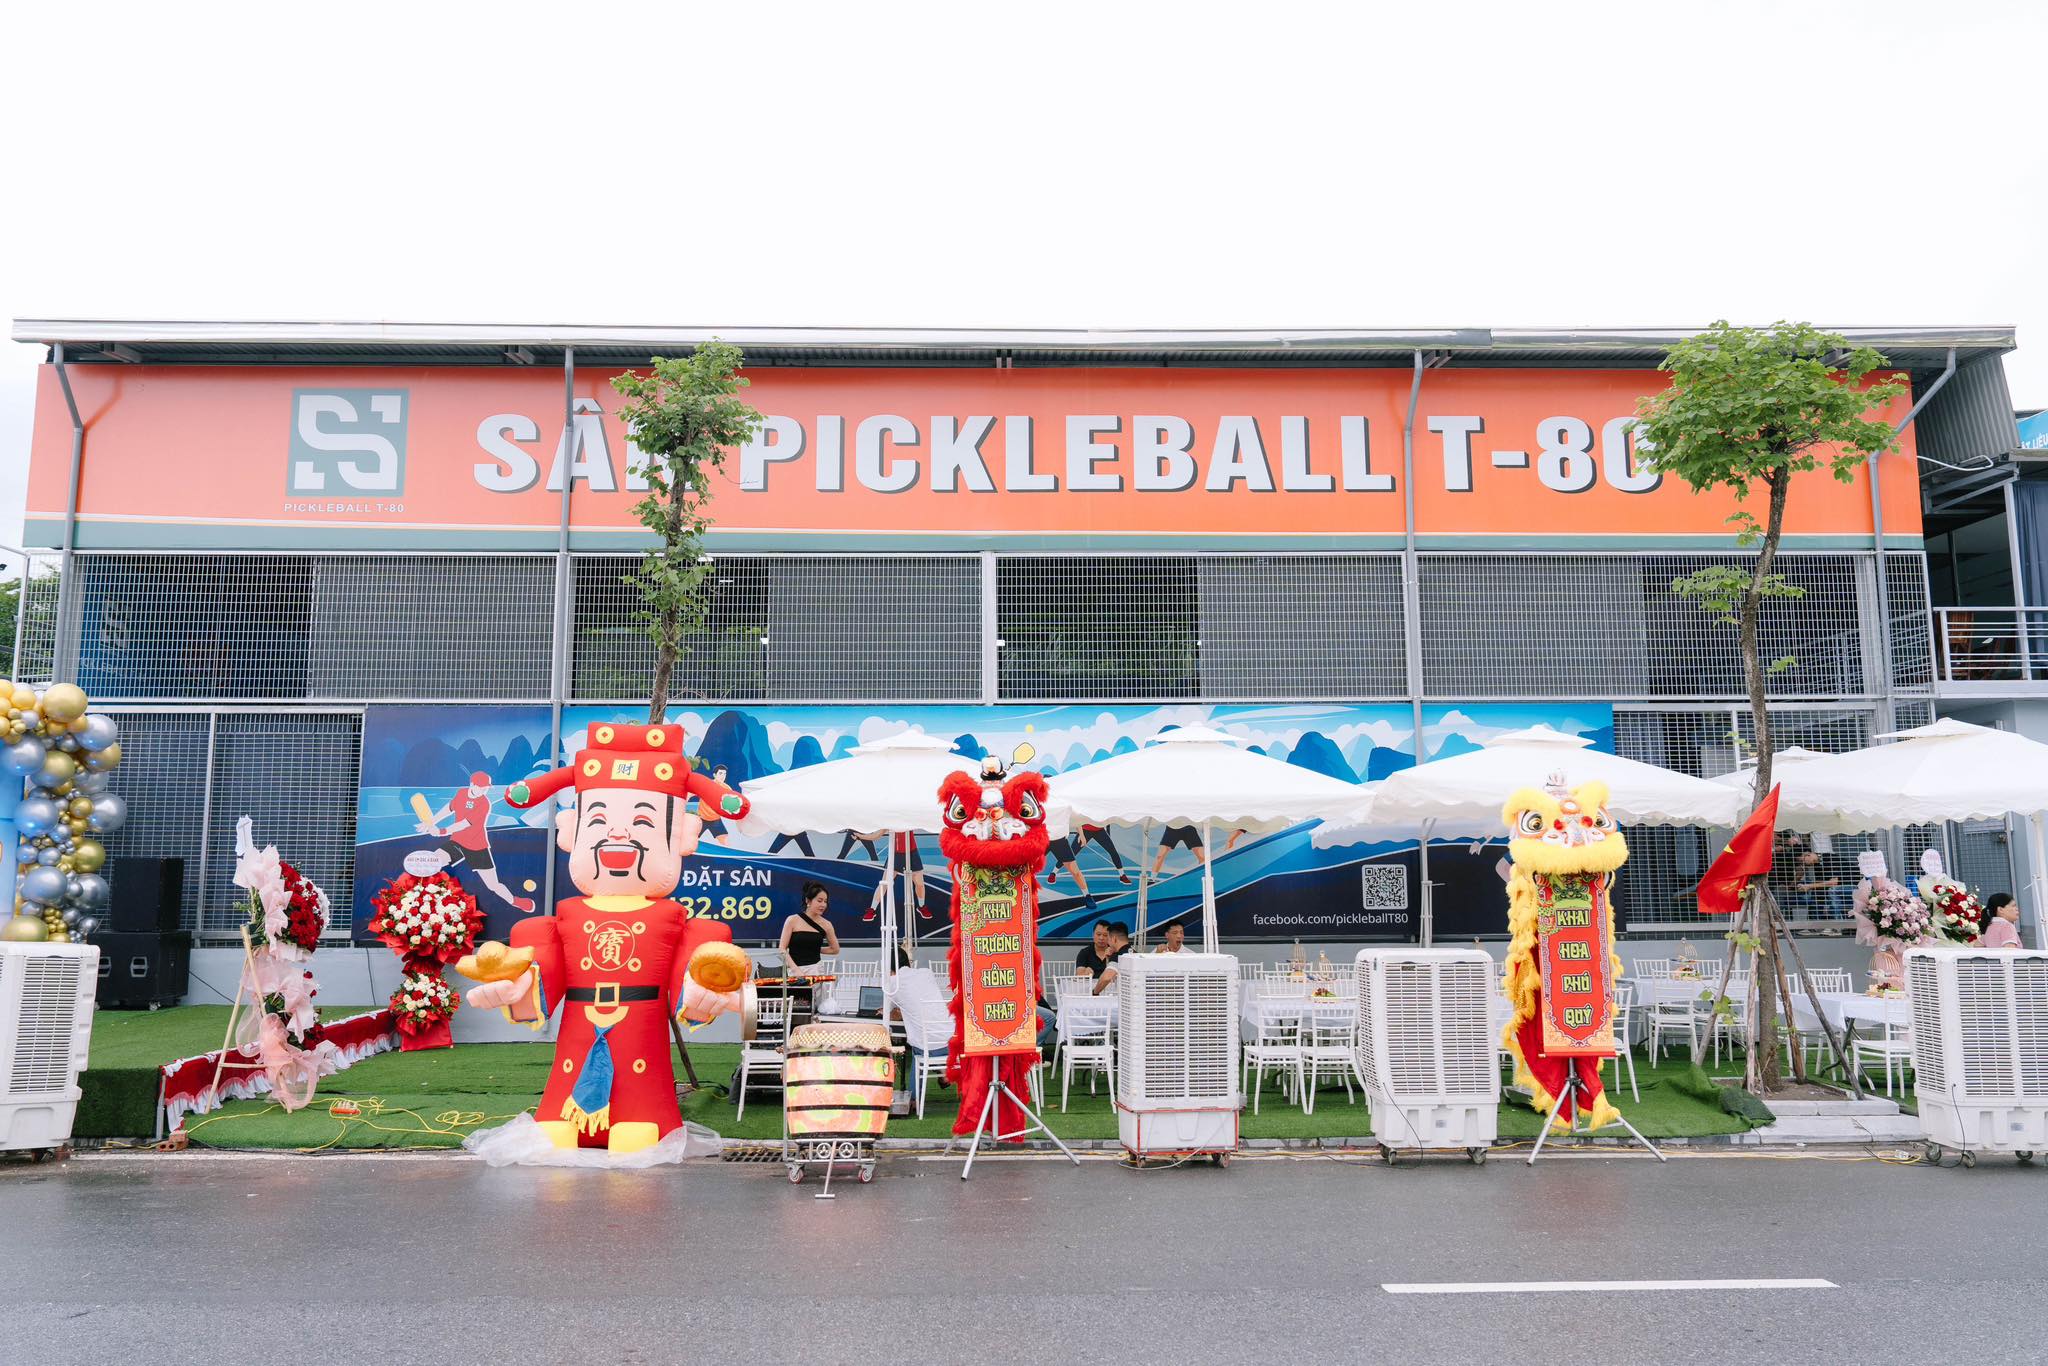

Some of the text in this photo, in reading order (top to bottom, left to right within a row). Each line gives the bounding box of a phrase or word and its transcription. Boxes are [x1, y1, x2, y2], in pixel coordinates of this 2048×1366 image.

[739, 414, 1396, 493] PICKLEBALL
[1427, 415, 1663, 493] T-80
[284, 503, 404, 513] PICKLEBALL T-80
[682, 865, 772, 891] ĐẶT SÂN
[670, 896, 772, 920] 32.869
[982, 902, 1011, 919] KHAI
[1253, 912, 1409, 926] facebook.com/pickleballT80
[1557, 910, 1589, 926] KHAI
[1560, 942, 1590, 959] HOA
